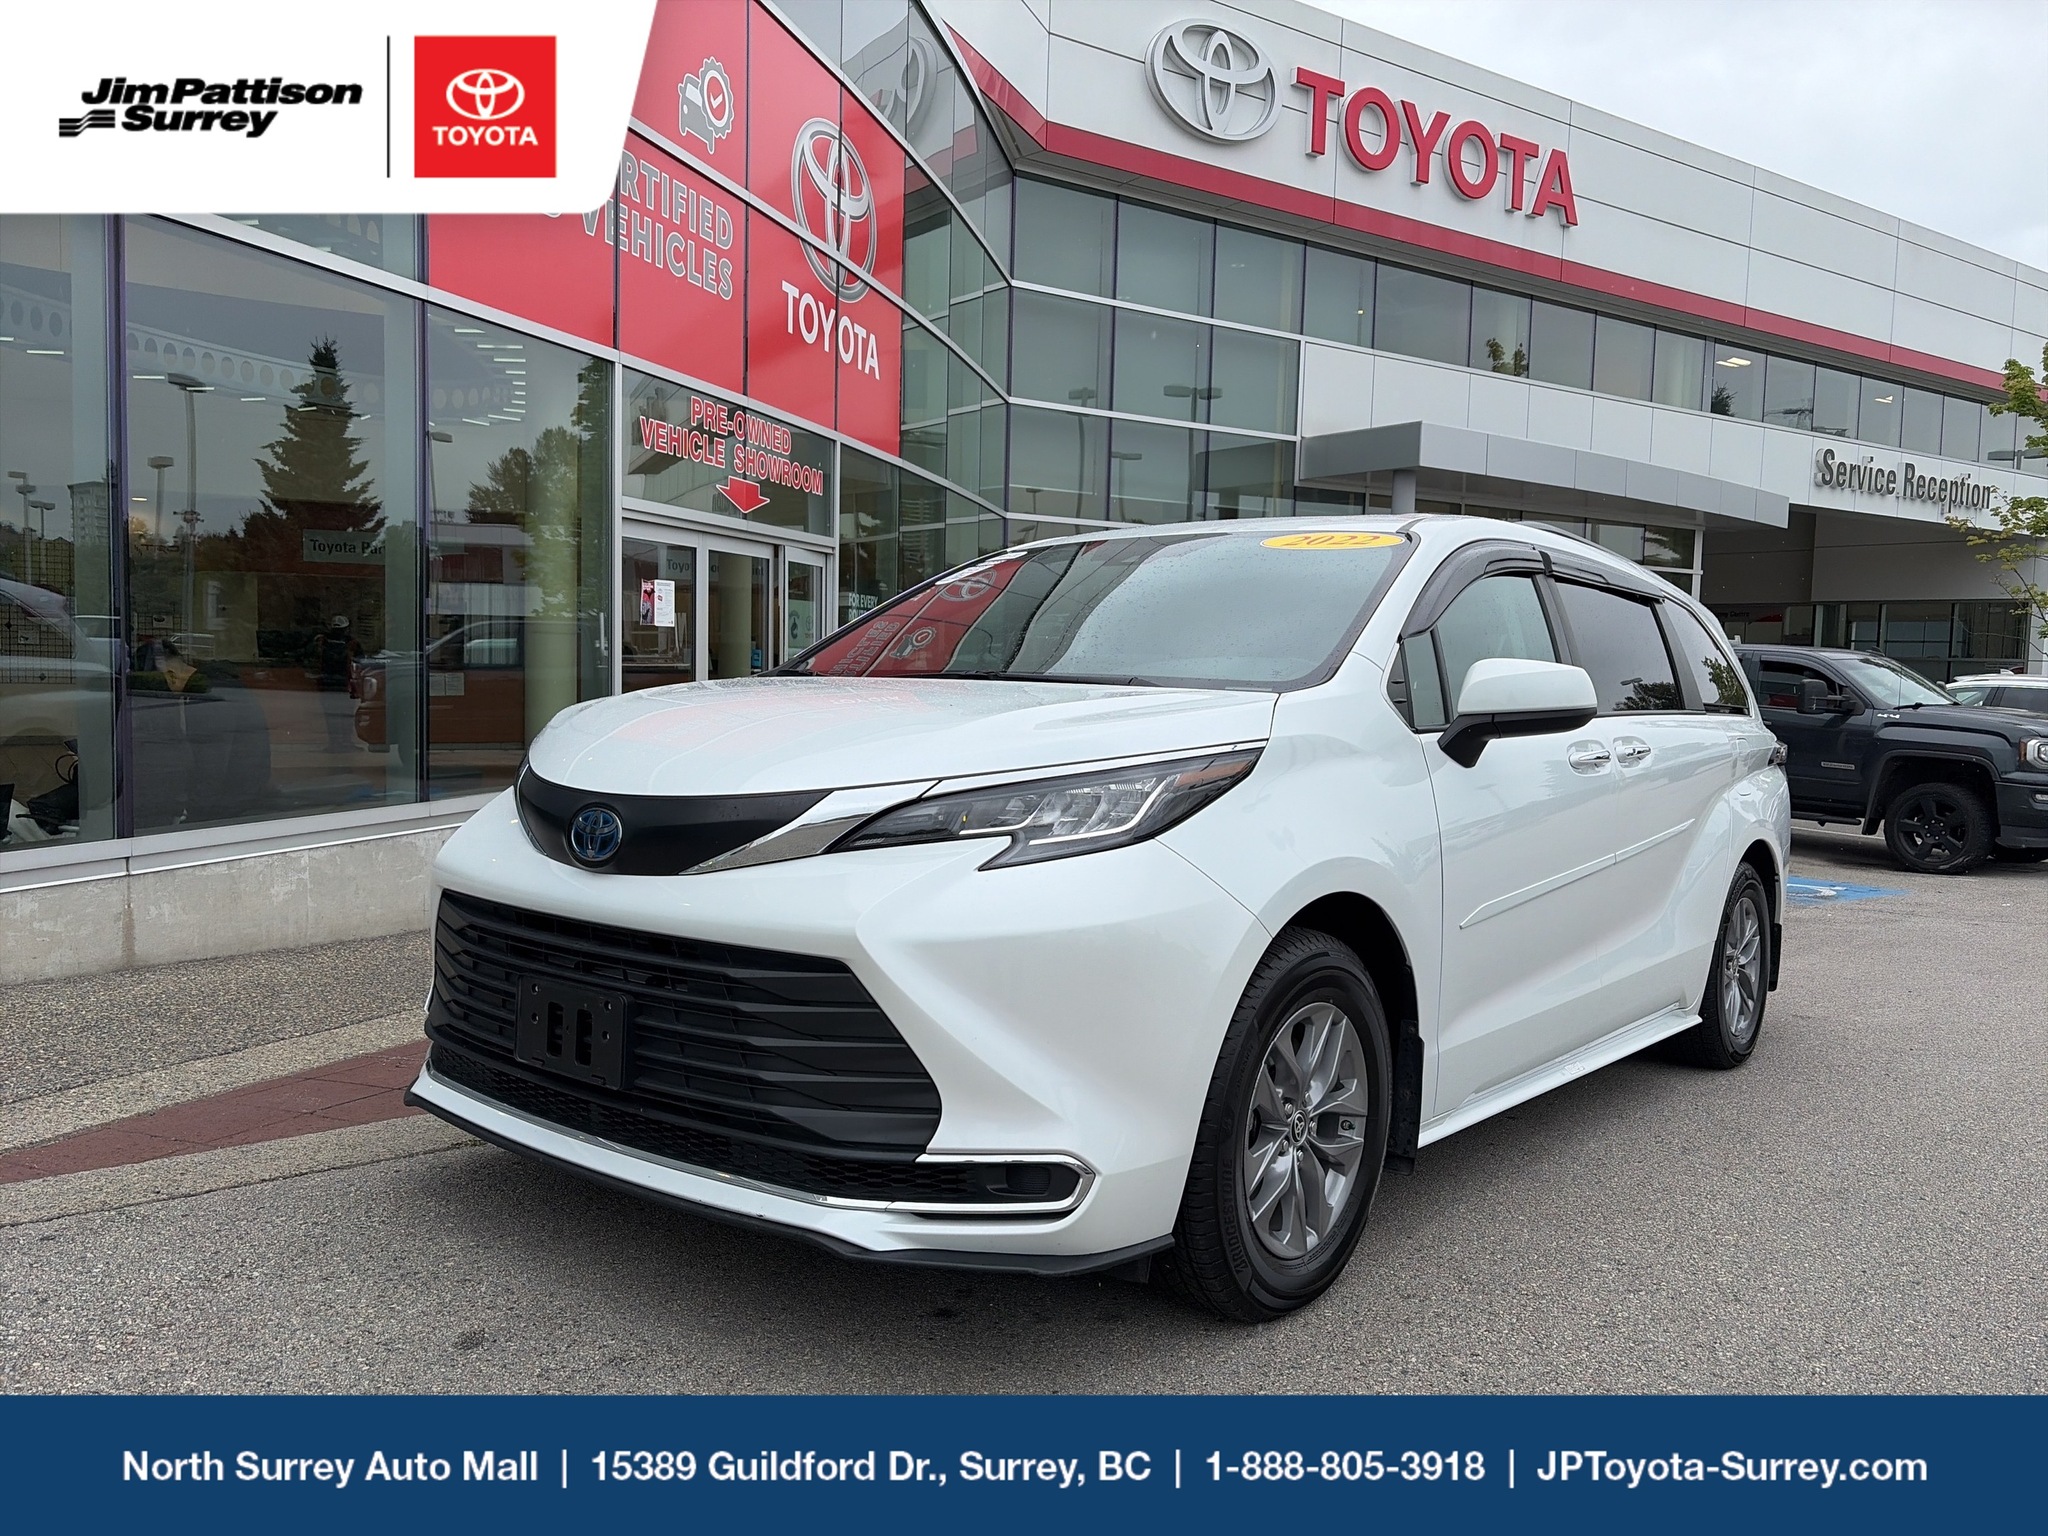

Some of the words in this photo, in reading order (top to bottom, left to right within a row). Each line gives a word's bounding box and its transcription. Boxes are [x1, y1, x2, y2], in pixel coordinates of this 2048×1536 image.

[1293, 67, 1578, 226] TOYOTA
[620, 150, 733, 250] RTIFIED
[782, 280, 880, 380] TOYOTA
[640, 416, 725, 468] VEHICLE
[734, 444, 823, 496] SHOWROOM
[690, 396, 791, 455] PRE-OWNED
[1819, 448, 1896, 495] Service
[1903, 463, 1991, 513] Reception
[310, 539, 356, 555] Toyota
[361, 541, 385, 554] Par
[666, 559, 692, 573] Toyo
[1284, 535, 1381, 546] 2022
[848, 592, 860, 607] FOR
[860, 594, 878, 608] EVERY
